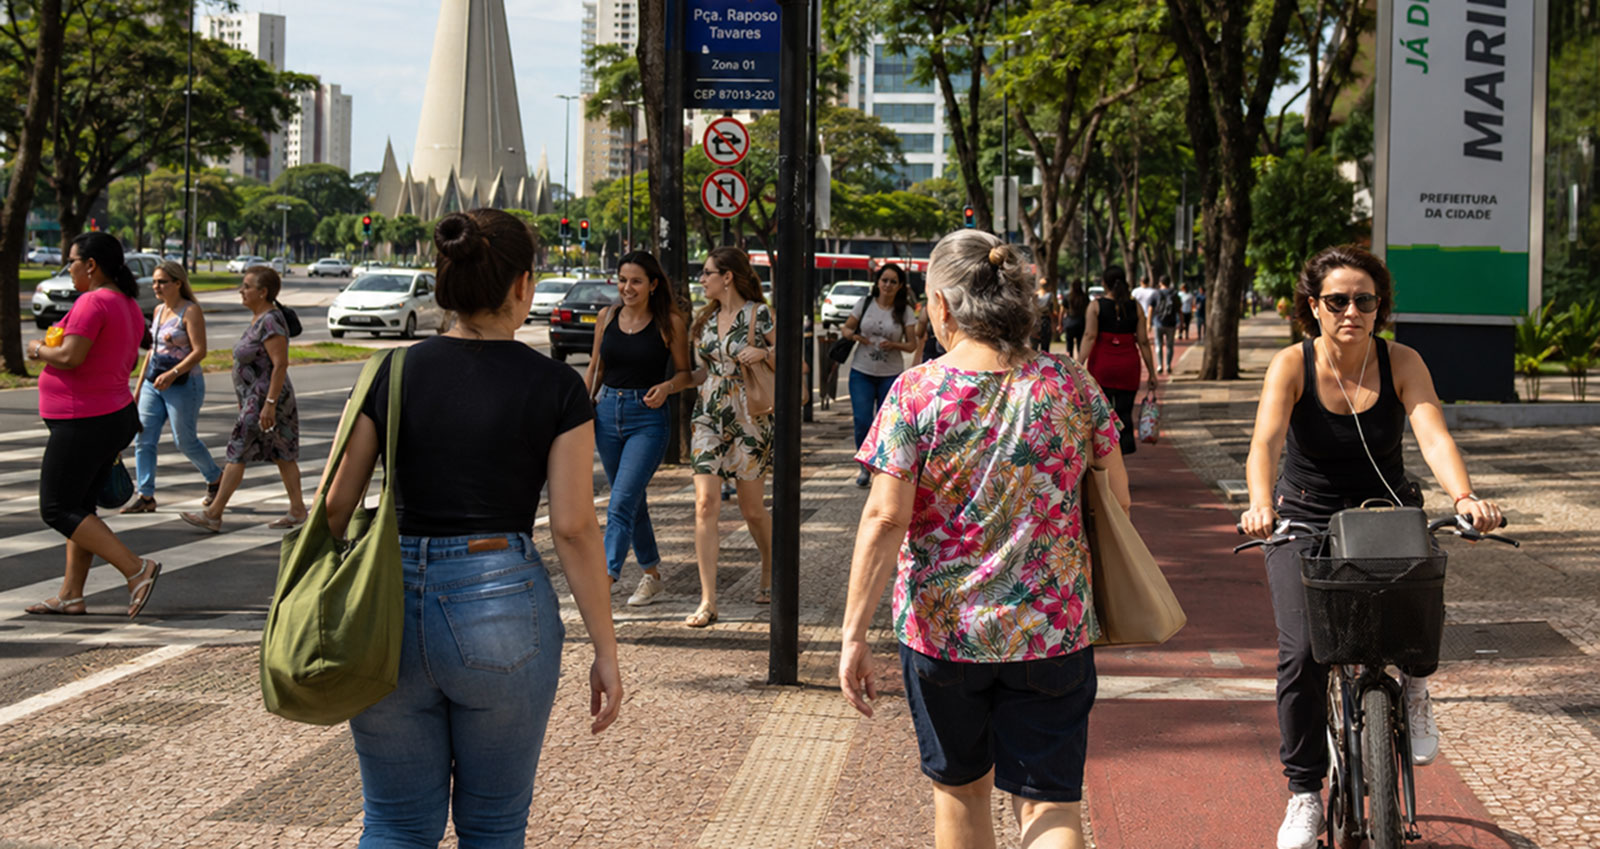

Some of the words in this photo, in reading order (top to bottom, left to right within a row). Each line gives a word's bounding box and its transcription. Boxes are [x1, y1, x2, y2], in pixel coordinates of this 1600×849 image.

[694, 8, 722, 24] Pça.
[727, 8, 778, 24] Raposo
[1406, 0, 1430, 27] D
[709, 26, 761, 39] Tavares
[1400, 37, 1429, 75] JÁ
[711, 59, 739, 70] Zona
[742, 59, 755, 70] 01
[1463, 0, 1507, 162] MARI
[693, 89, 716, 100] CEP
[718, 89, 776, 100] 87013-220
[1424, 208, 1443, 218] DA
[1445, 208, 1492, 220] CIDADE
